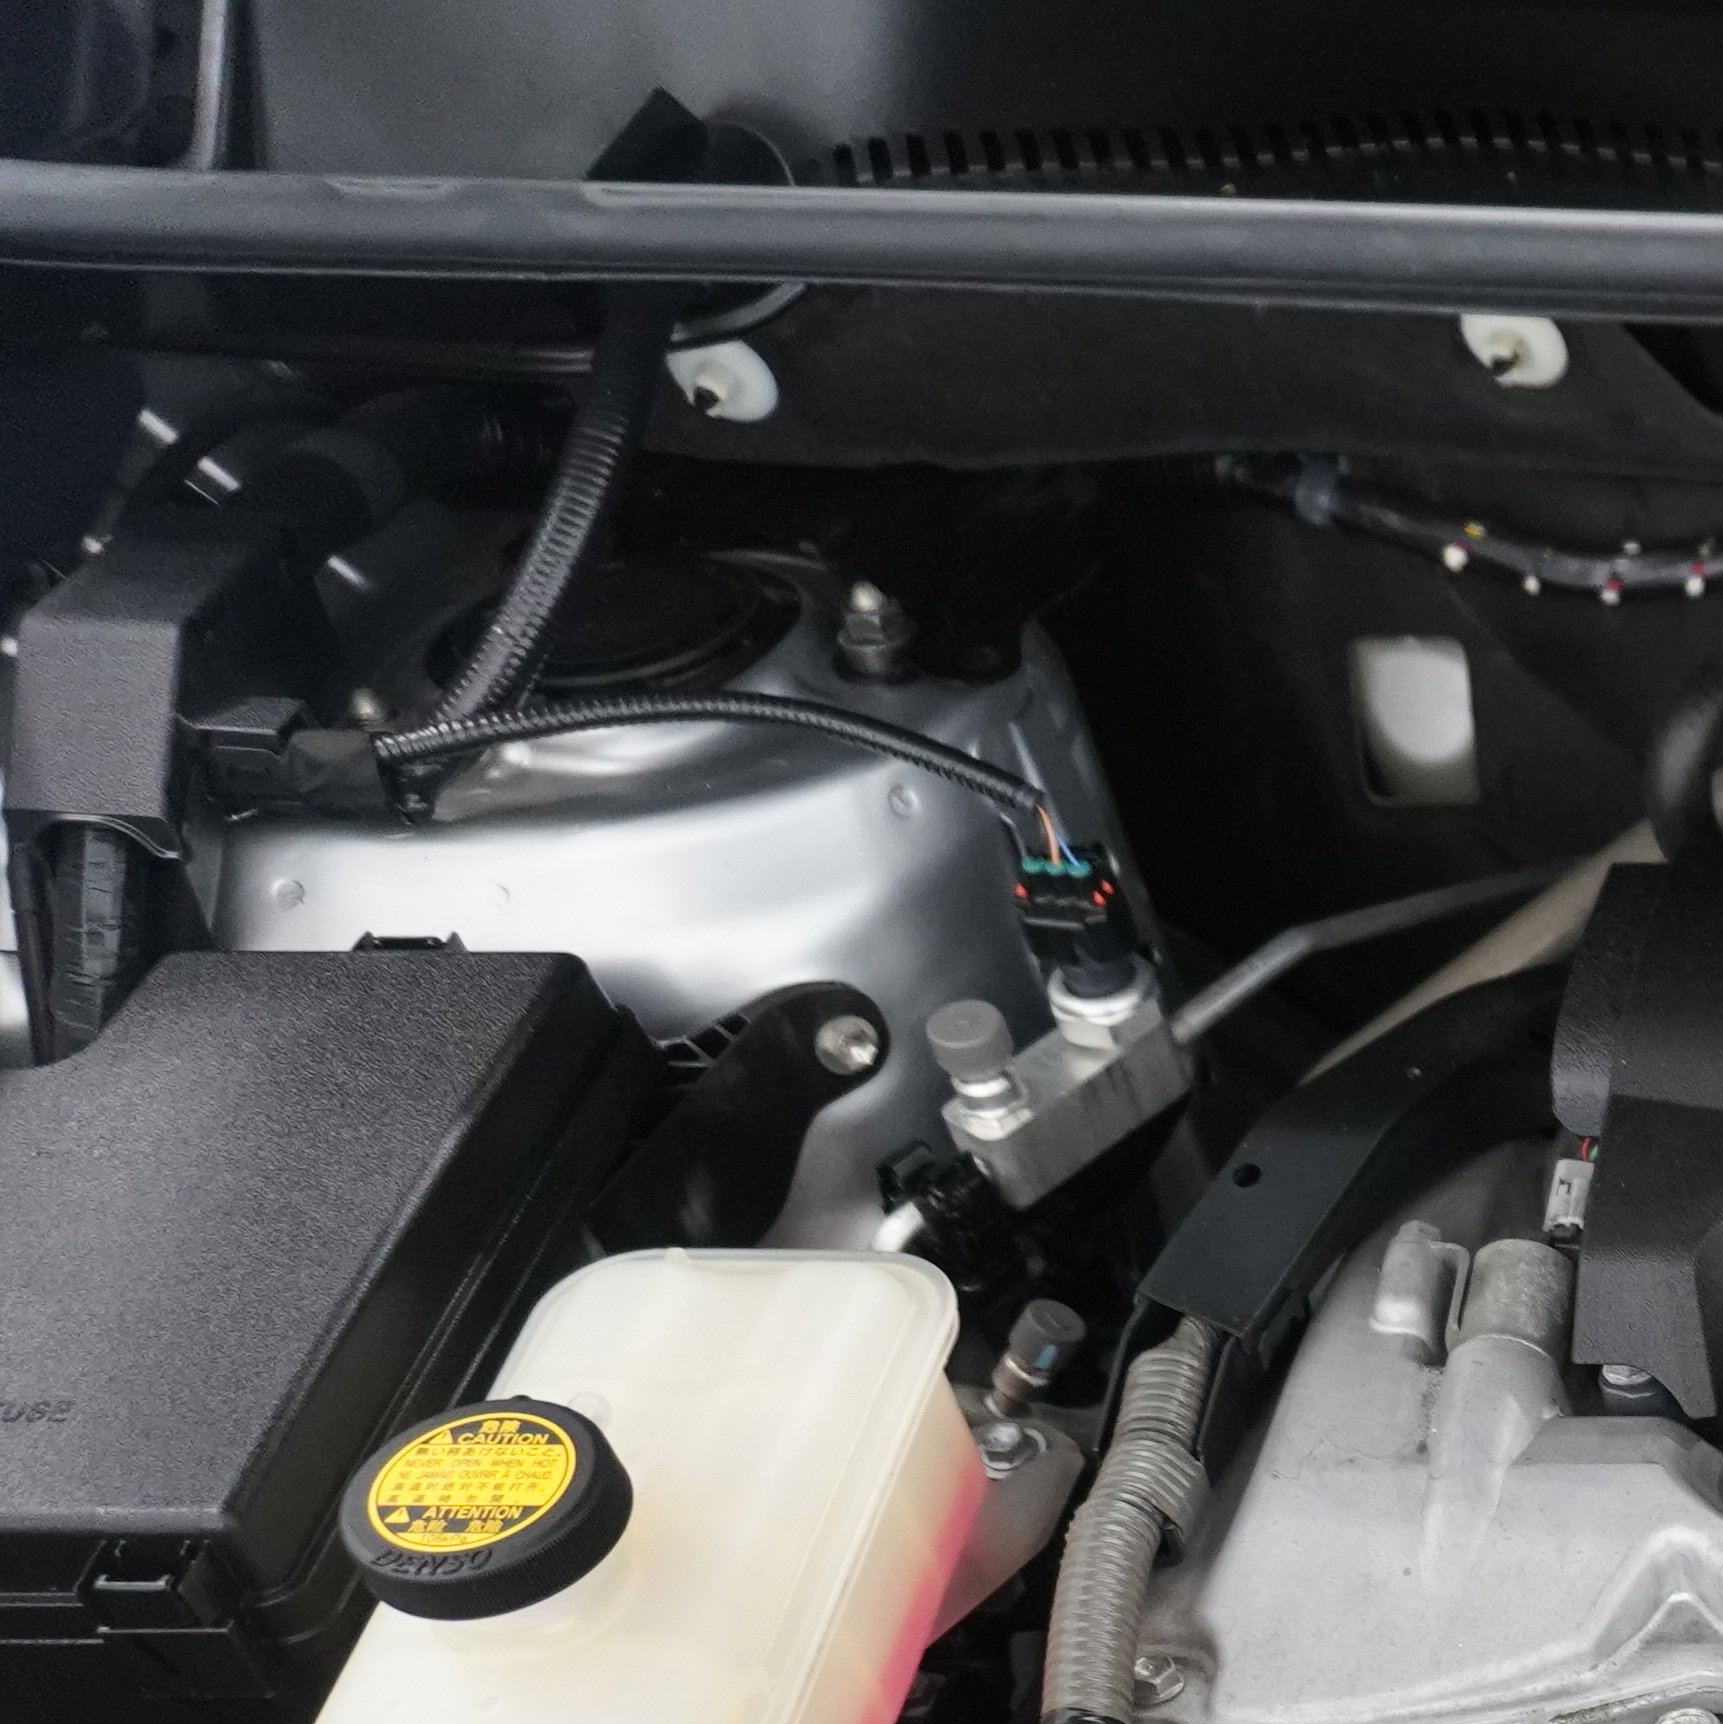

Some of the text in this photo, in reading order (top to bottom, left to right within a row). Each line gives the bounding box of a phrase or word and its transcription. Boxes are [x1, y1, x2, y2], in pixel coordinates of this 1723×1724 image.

[456, 1432, 550, 1445] CAUTION
[405, 1458, 442, 1468] NEVER
[450, 1458, 483, 1468] OPEN
[490, 1458, 524, 1468] WHEN
[398, 1470, 412, 1480] NE
[416, 1470, 455, 1480] JAMAIS
[459, 1469, 498, 1480] OUVRIR
[421, 1506, 524, 1520] ATTENTION
[370, 1549, 493, 1577] DENSO
